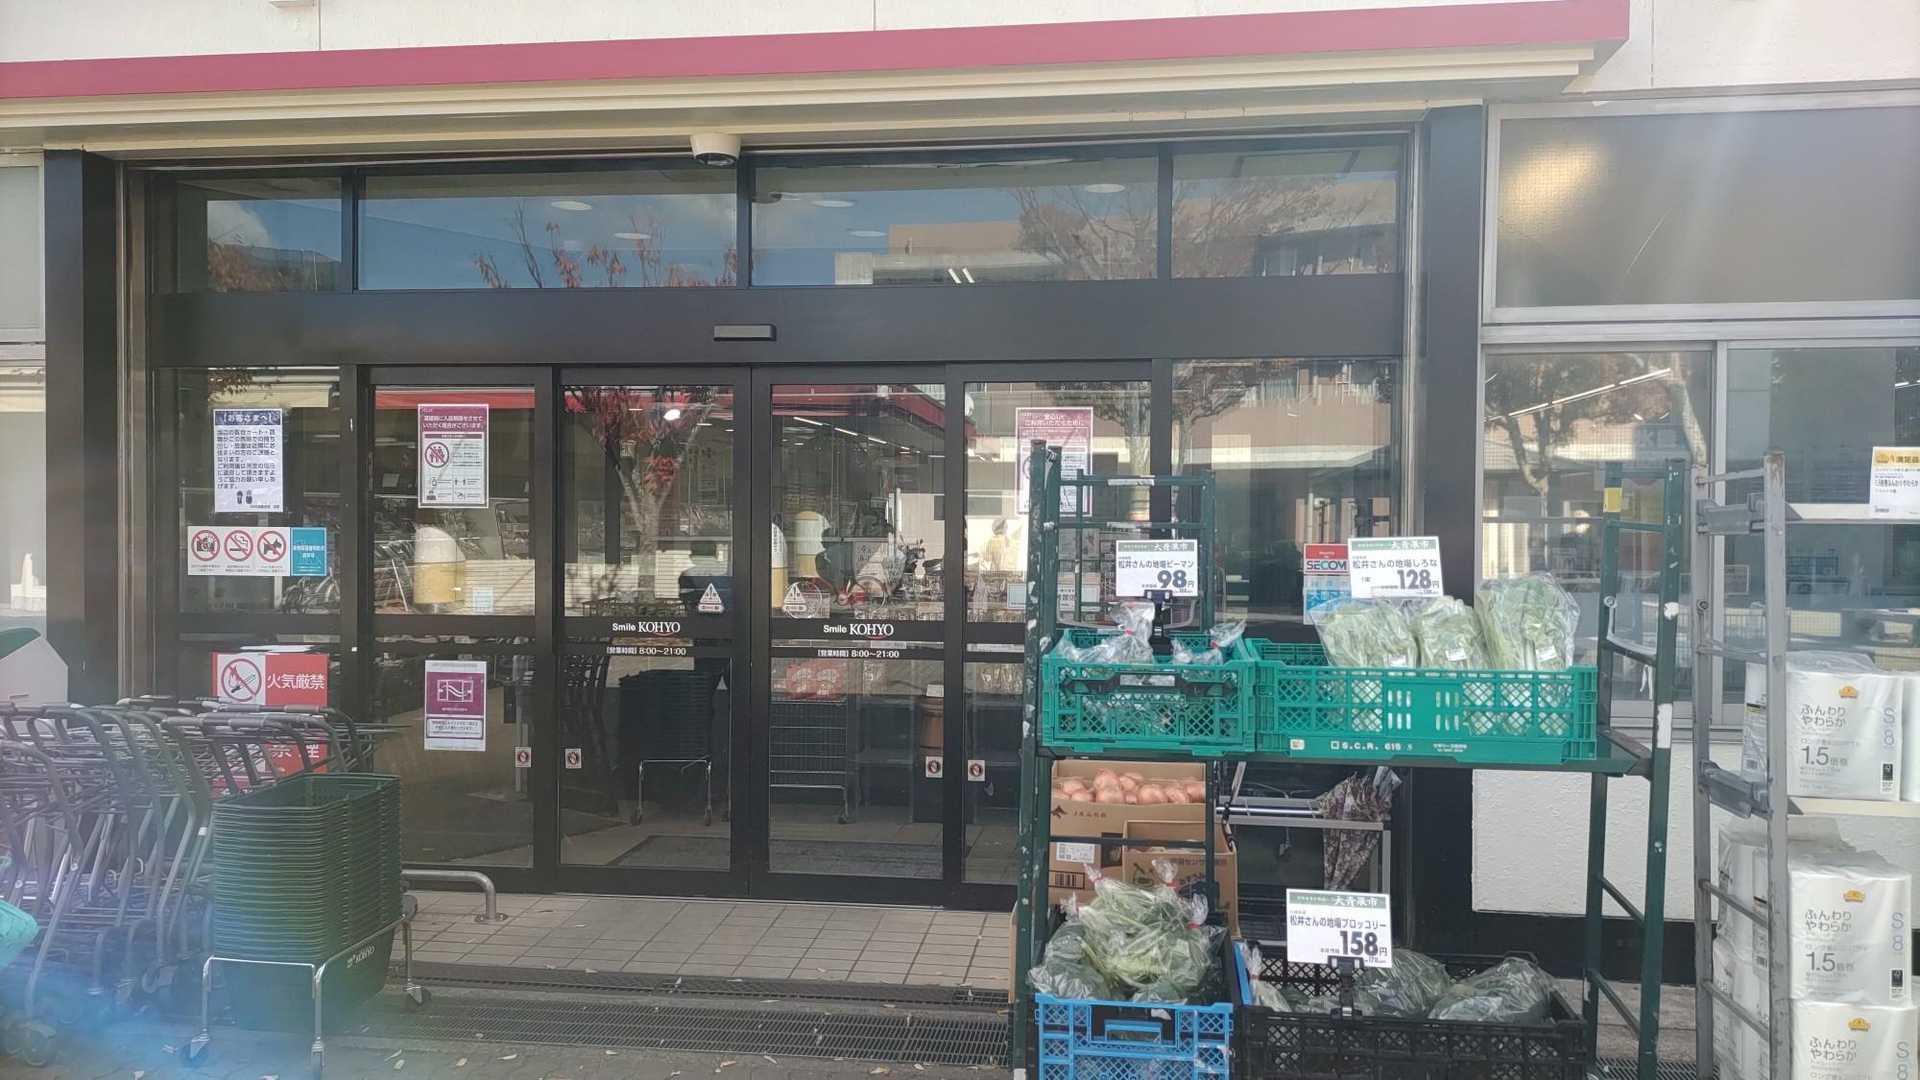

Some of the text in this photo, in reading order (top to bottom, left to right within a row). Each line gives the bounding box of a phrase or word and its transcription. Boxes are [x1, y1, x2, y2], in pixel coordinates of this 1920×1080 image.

[1306, 560, 1347, 570] SECOM
[612, 621, 680, 633] Smile KOHYO
[823, 623, 894, 636] Smile KOHYO
[267, 673, 325, 690] 火気厳禁
[1800, 703, 1846, 716] ふんわり
[1800, 715, 1846, 728] やわらか
[1805, 908, 1851, 920] ふんわり
[1805, 920, 1852, 932] やわらか
[1809, 1036, 1856, 1049] ふんわり
[1809, 1048, 1856, 1061] やわらか
